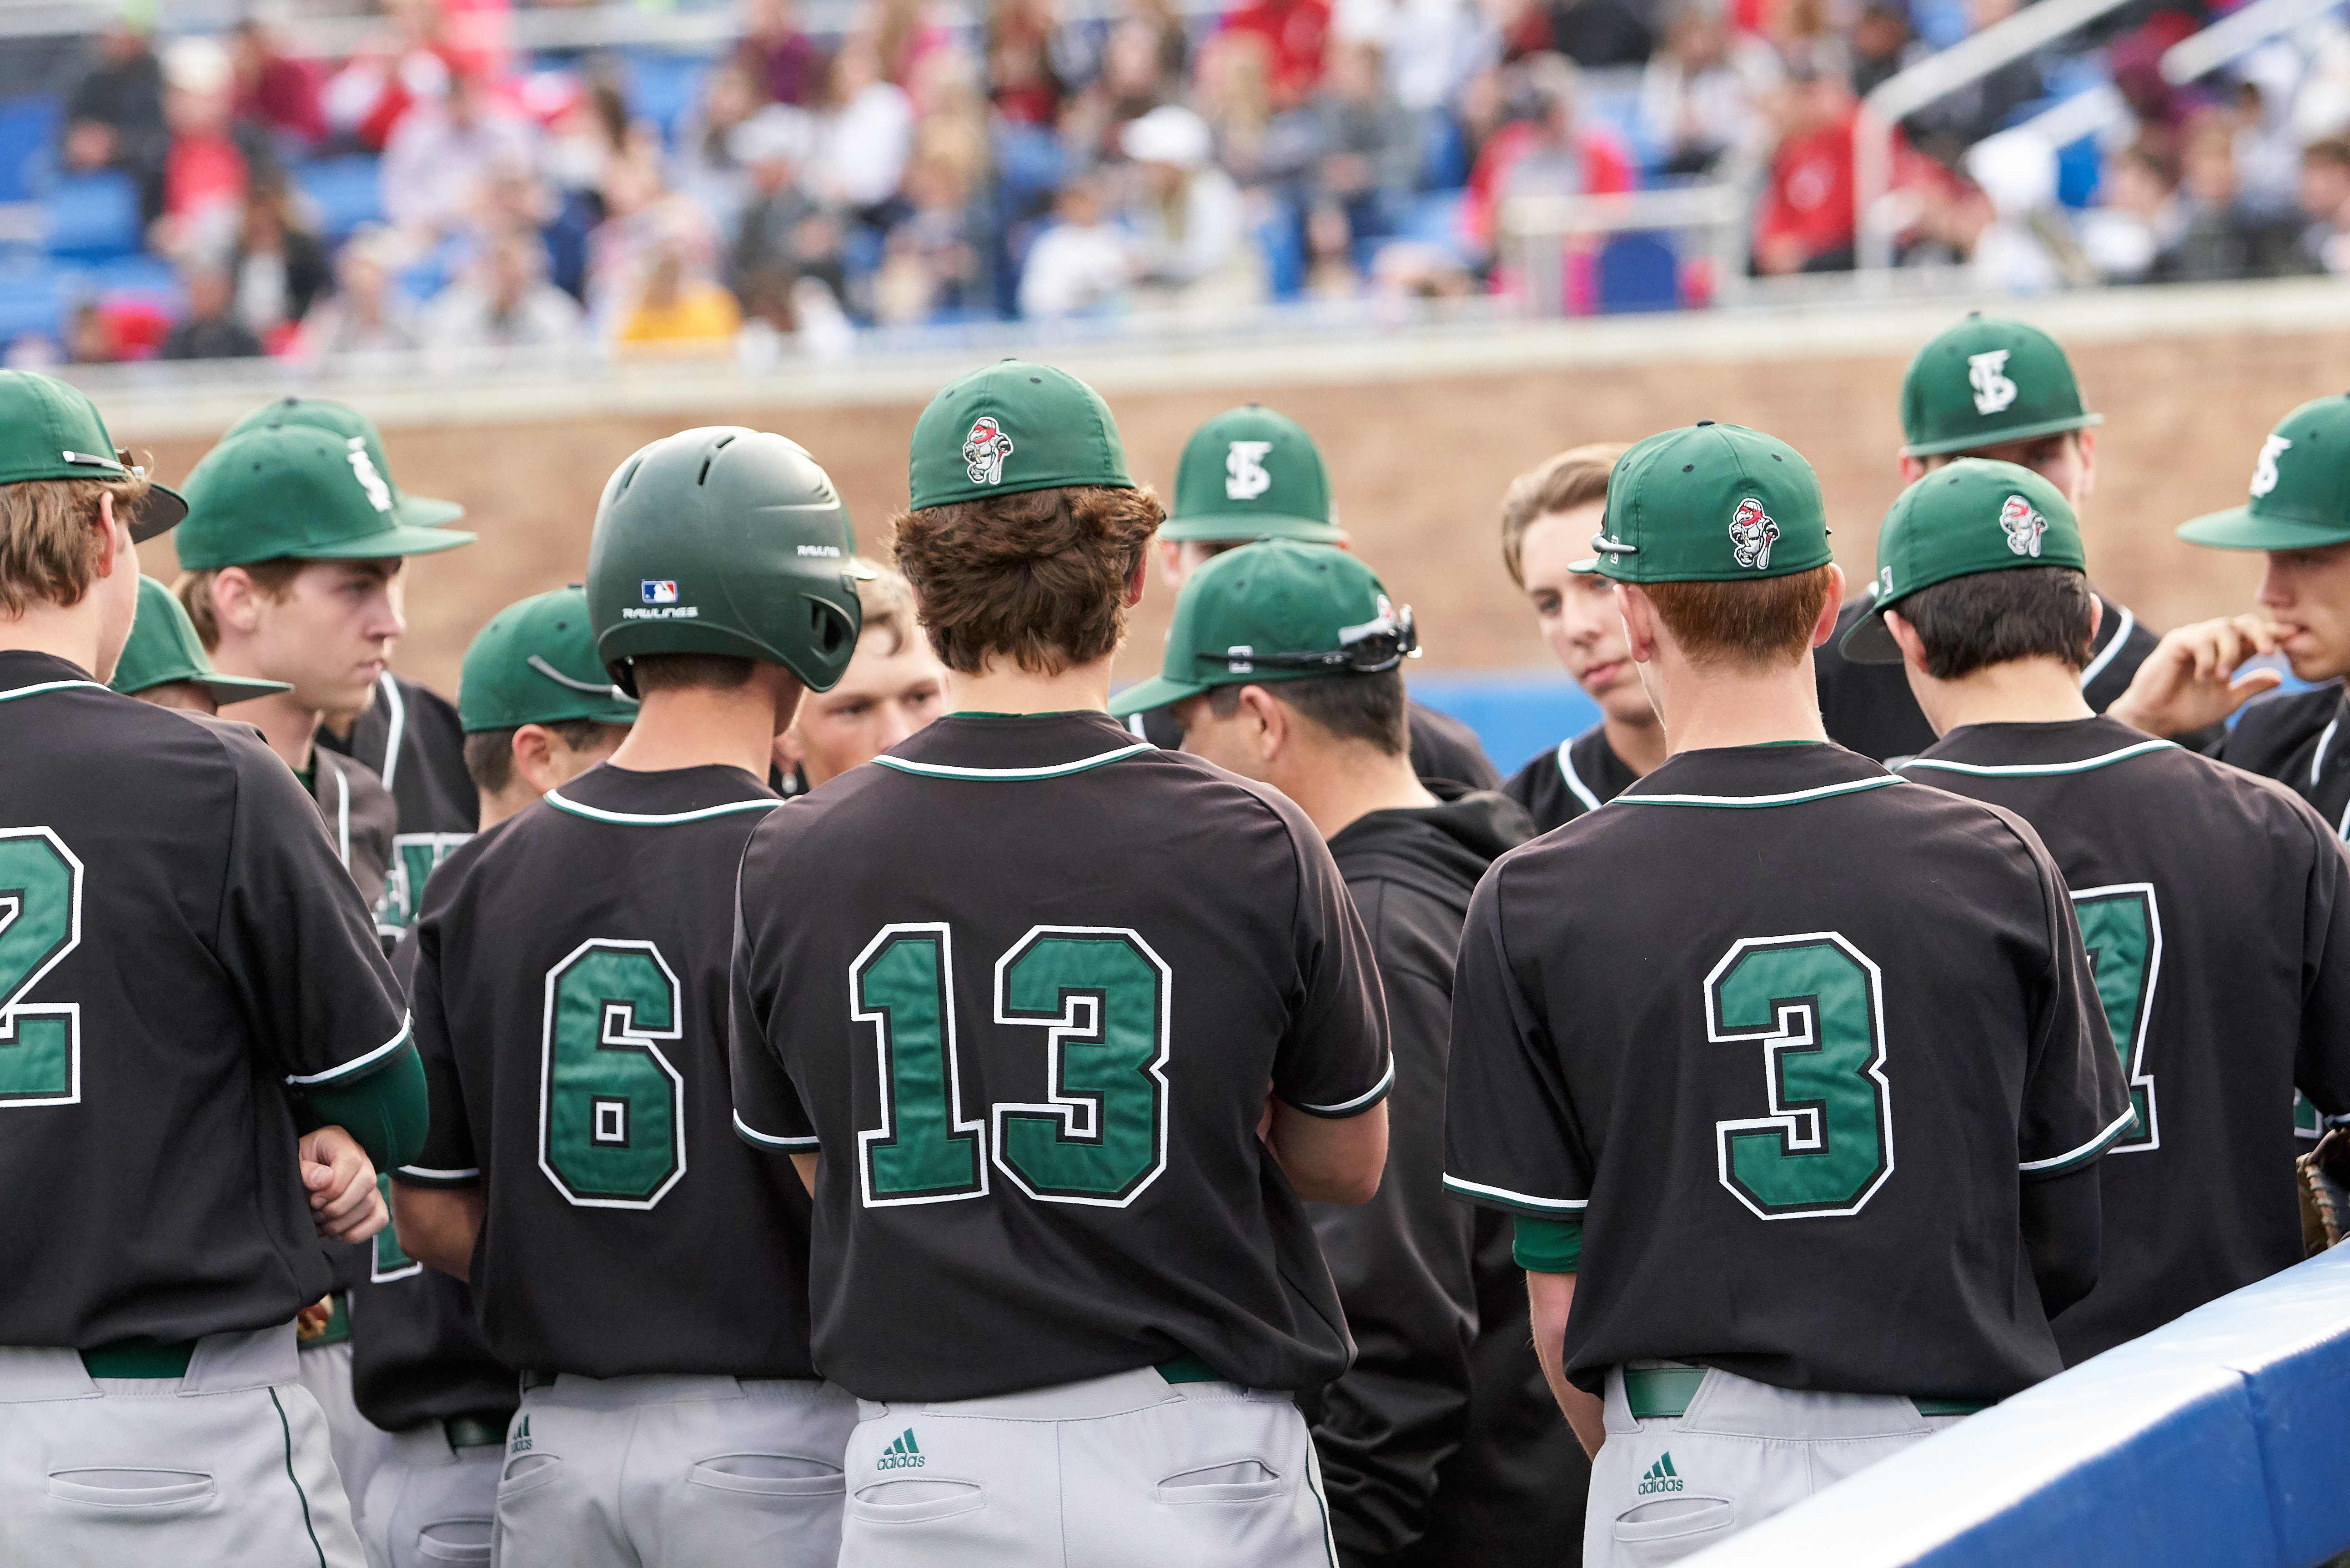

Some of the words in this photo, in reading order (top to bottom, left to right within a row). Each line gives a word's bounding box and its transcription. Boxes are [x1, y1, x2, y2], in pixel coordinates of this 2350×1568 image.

[622, 606, 698, 619] RAWLINGS
[538, 937, 688, 1210] 6
[848, 921, 1172, 1208] 13
[1703, 930, 1895, 1221] 3
[877, 1452, 925, 1471] adidas
[1638, 1476, 1683, 1495] adidas
